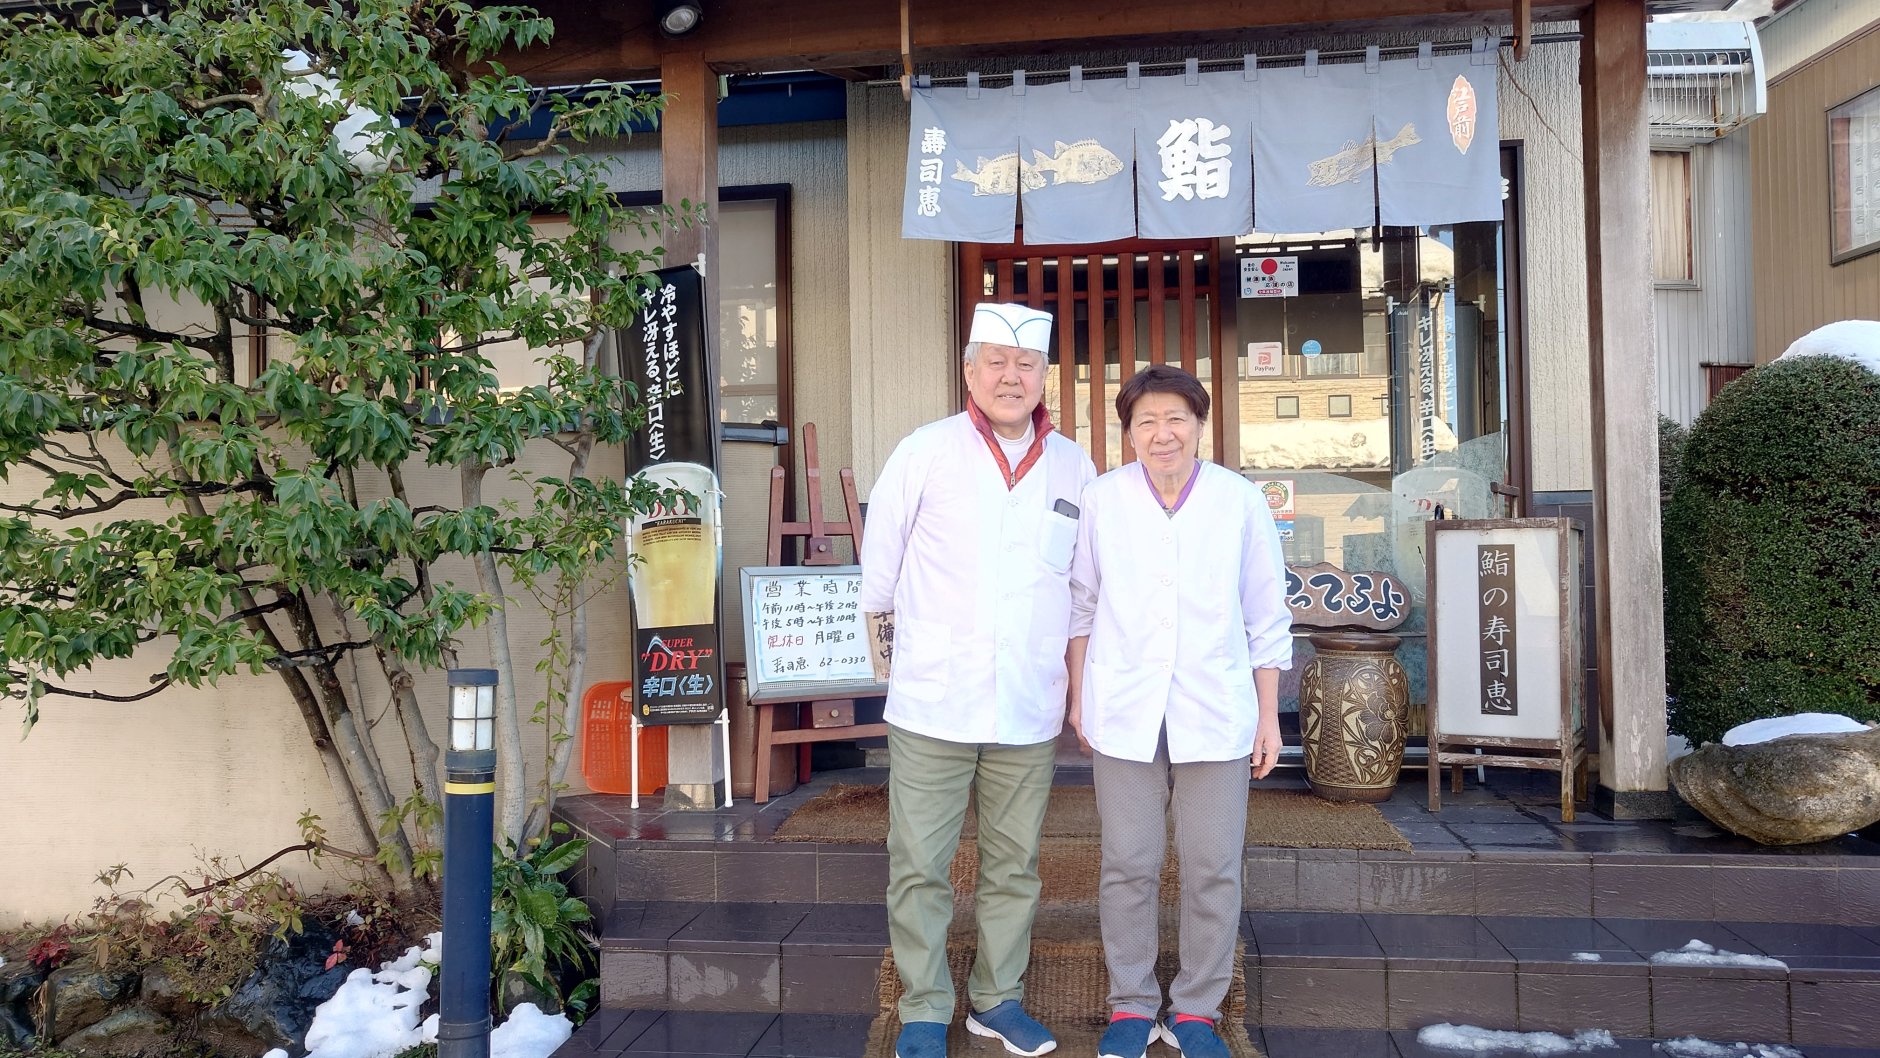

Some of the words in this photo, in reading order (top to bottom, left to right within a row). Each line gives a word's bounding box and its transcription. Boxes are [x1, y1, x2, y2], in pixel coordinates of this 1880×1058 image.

[1452, 86, 1472, 138] 江戸前
[1156, 117, 1232, 201] 鮨
[660, 283, 681, 399] 冷やすほどに
[765, 579, 862, 598] 営業時間
[661, 637, 693, 648] SUPER
[815, 630, 855, 646] 月曜日
[1479, 549, 1512, 711] 鮨の寿司恵
[819, 656, 866, 668] 62-0330
